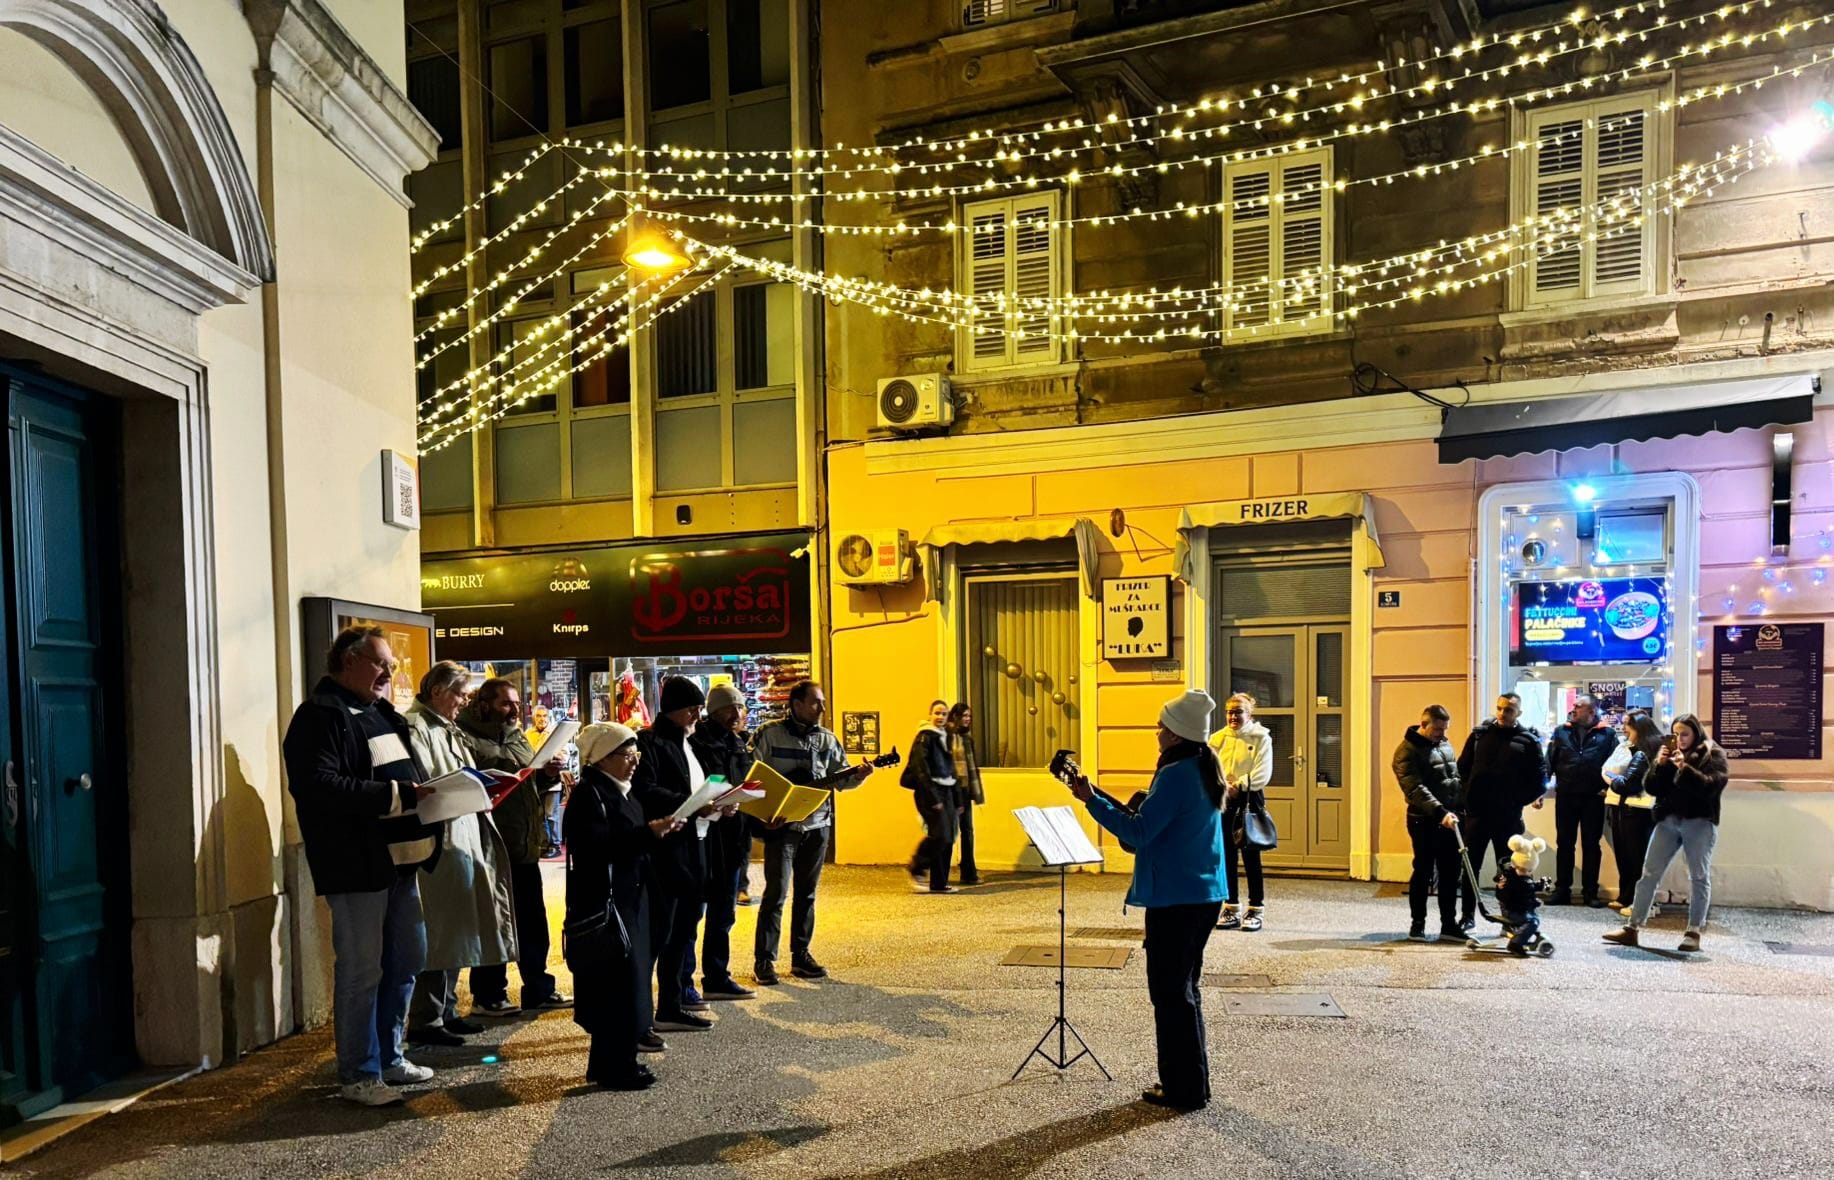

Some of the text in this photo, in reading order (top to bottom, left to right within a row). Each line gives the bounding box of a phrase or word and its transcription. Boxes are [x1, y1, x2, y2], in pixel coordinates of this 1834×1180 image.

[1240, 499, 1309, 519] FRIZER
[442, 574, 485, 590] BURRY
[633, 561, 786, 632] Borša
[1385, 592, 1392, 602] 5
[450, 626, 504, 638] DESIGN
[553, 623, 589, 636] Knirps
[1591, 683, 1625, 692] SNOW
